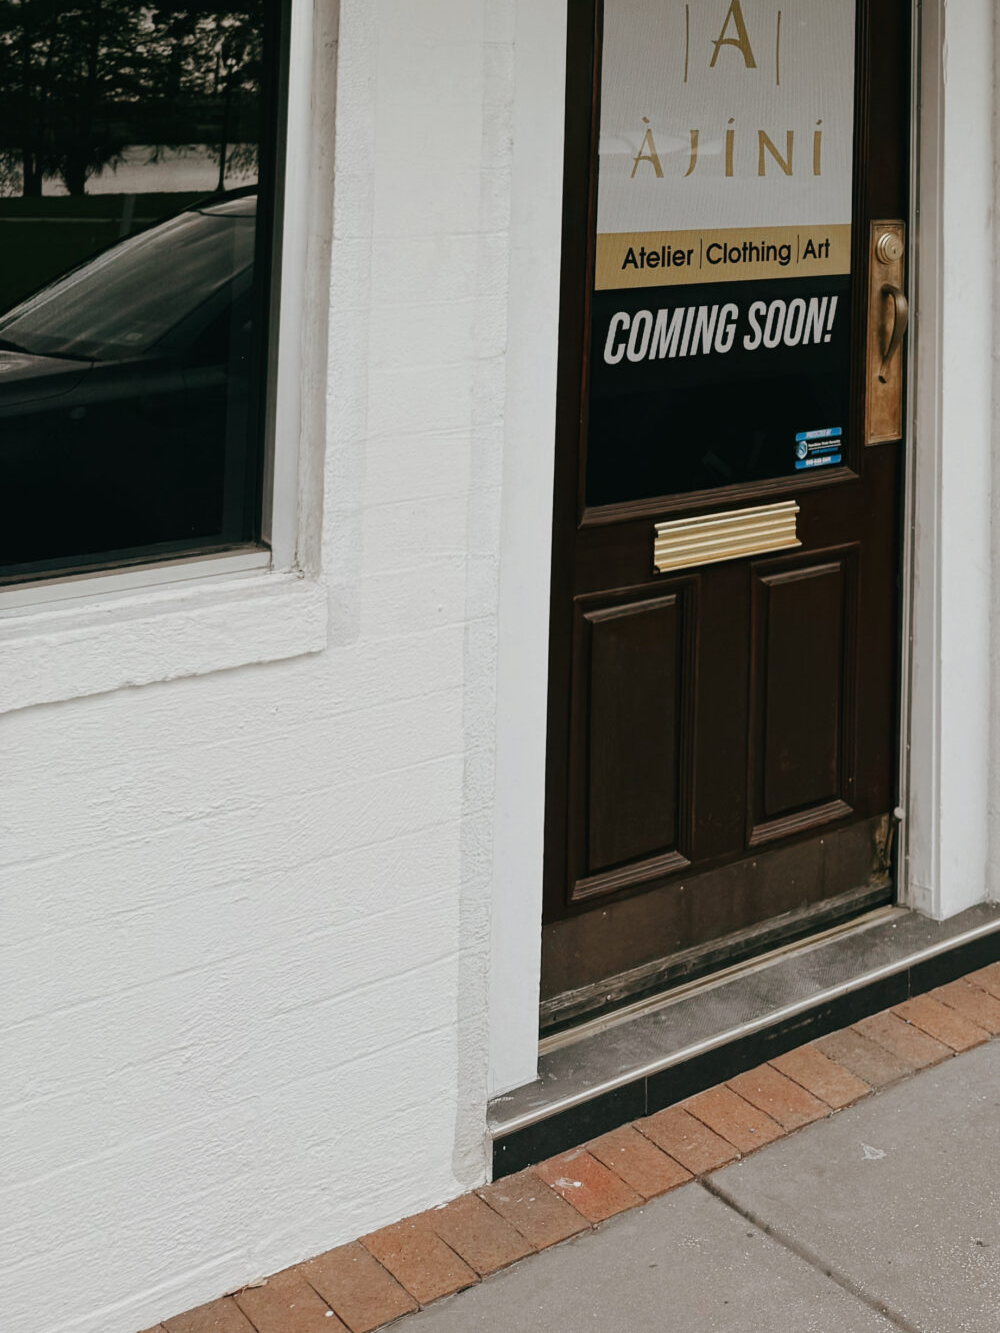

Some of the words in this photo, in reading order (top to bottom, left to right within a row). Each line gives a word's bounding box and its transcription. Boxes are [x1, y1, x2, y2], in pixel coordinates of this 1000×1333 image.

[621, 245, 694, 270] Atelier
[706, 241, 791, 266] Clothing
[802, 238, 830, 260] Art
[603, 303, 739, 365] COMING
[743, 295, 838, 351] SOON!
